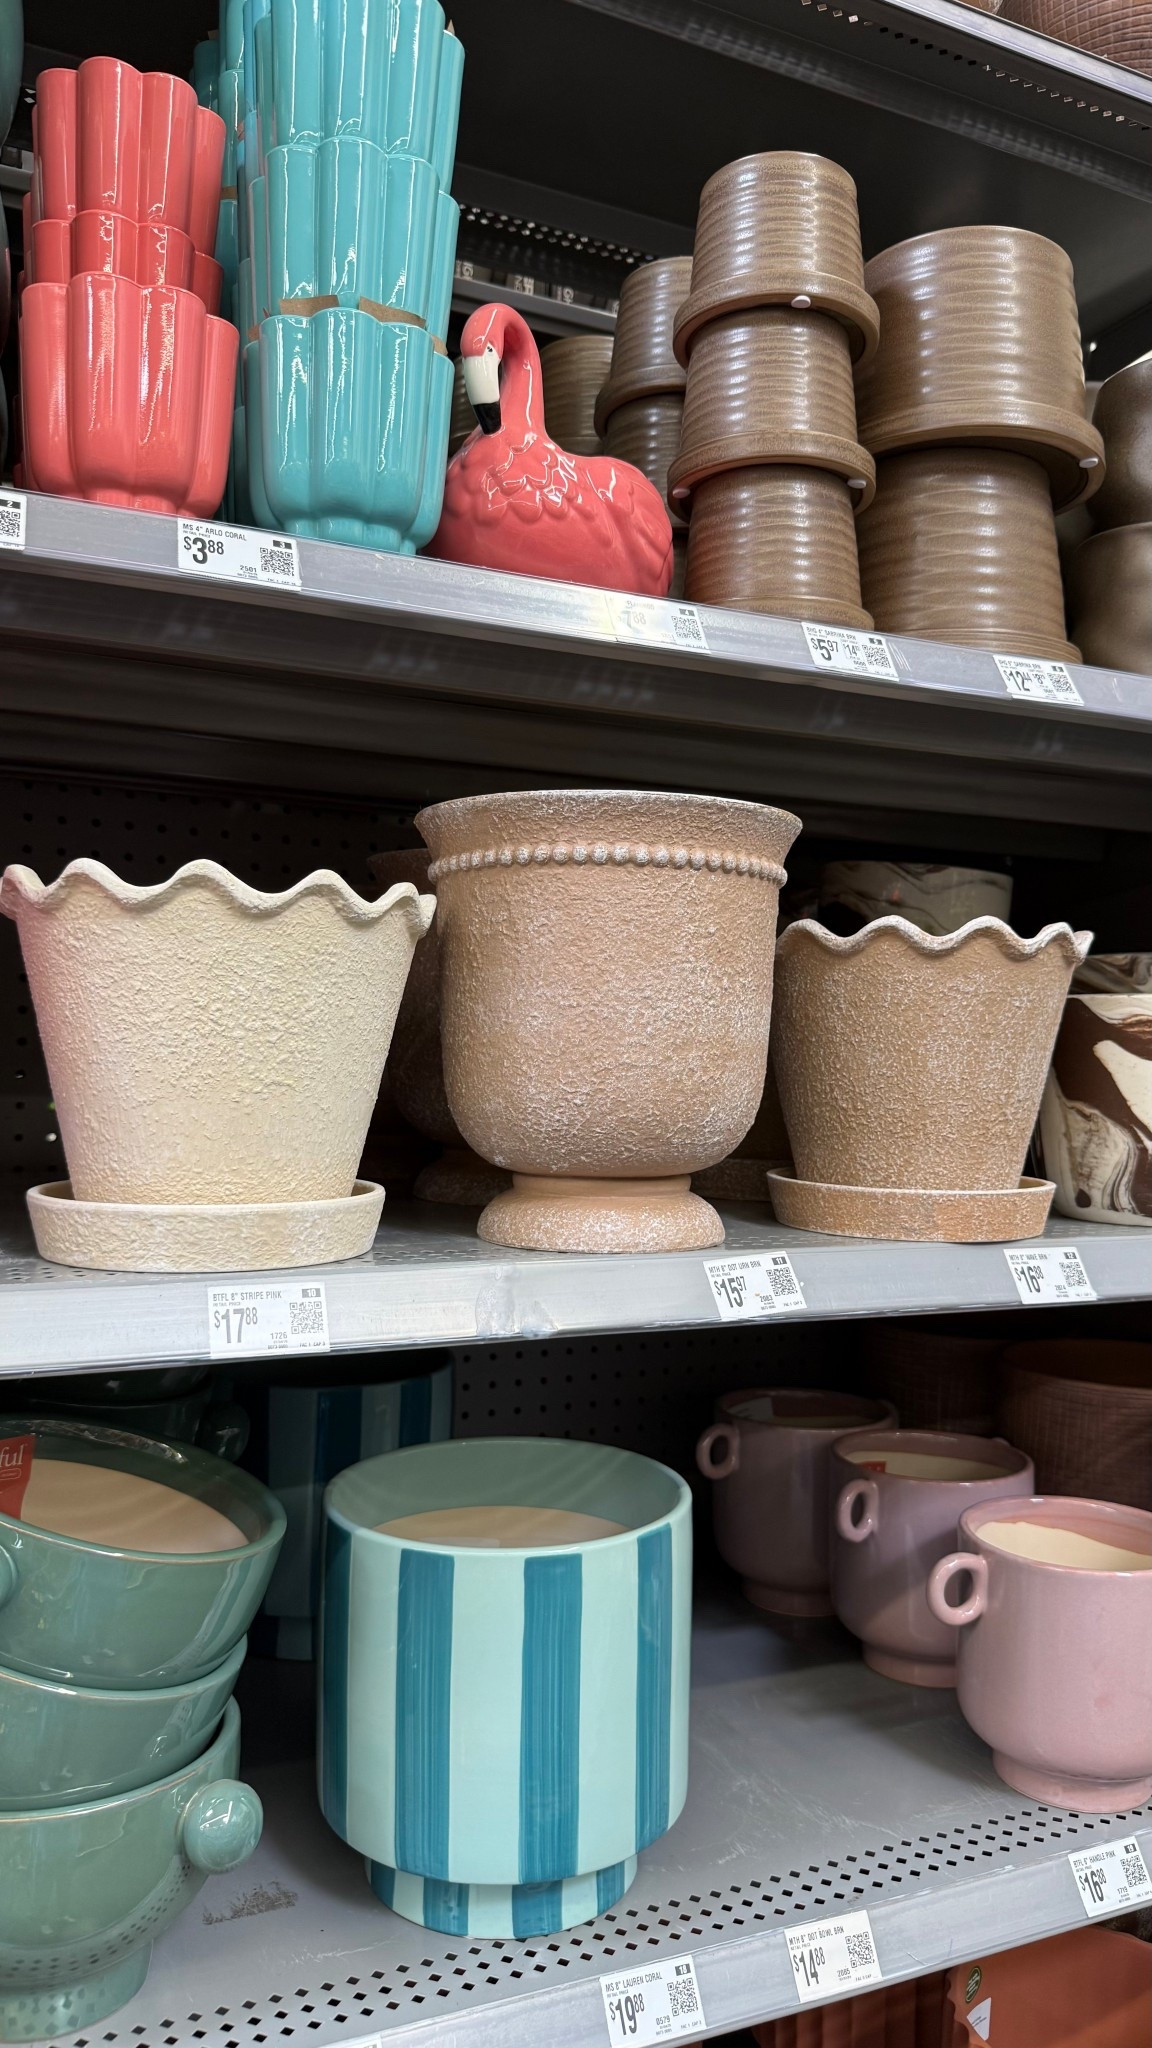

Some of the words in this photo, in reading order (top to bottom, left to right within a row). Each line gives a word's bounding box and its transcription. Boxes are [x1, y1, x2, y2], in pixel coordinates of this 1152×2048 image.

[206, 528, 222, 536] ARLO
[225, 531, 246, 541] CORAL
[240, 565, 257, 573] 2501
[709, 1265, 720, 1273] MTH
[750, 1260, 761, 1268] BRN
[213, 1292, 228, 1301] BTFL
[241, 1291, 264, 1300] STRIPE
[266, 1291, 282, 1299] PINK
[307, 1289, 316, 1297] 10
[1089, 1853, 1105, 1863] HANDLE
[1105, 1850, 1116, 1859] PINK
[789, 1937, 800, 1945] MTH
[808, 1932, 817, 1941] DOT
[819, 1929, 833, 1938] BOWL
[678, 1965, 687, 1974] 18
[606, 1983, 614, 1992] MS
[623, 1976, 644, 1988] LAUREN
[645, 1972, 662, 1983] CORAL
